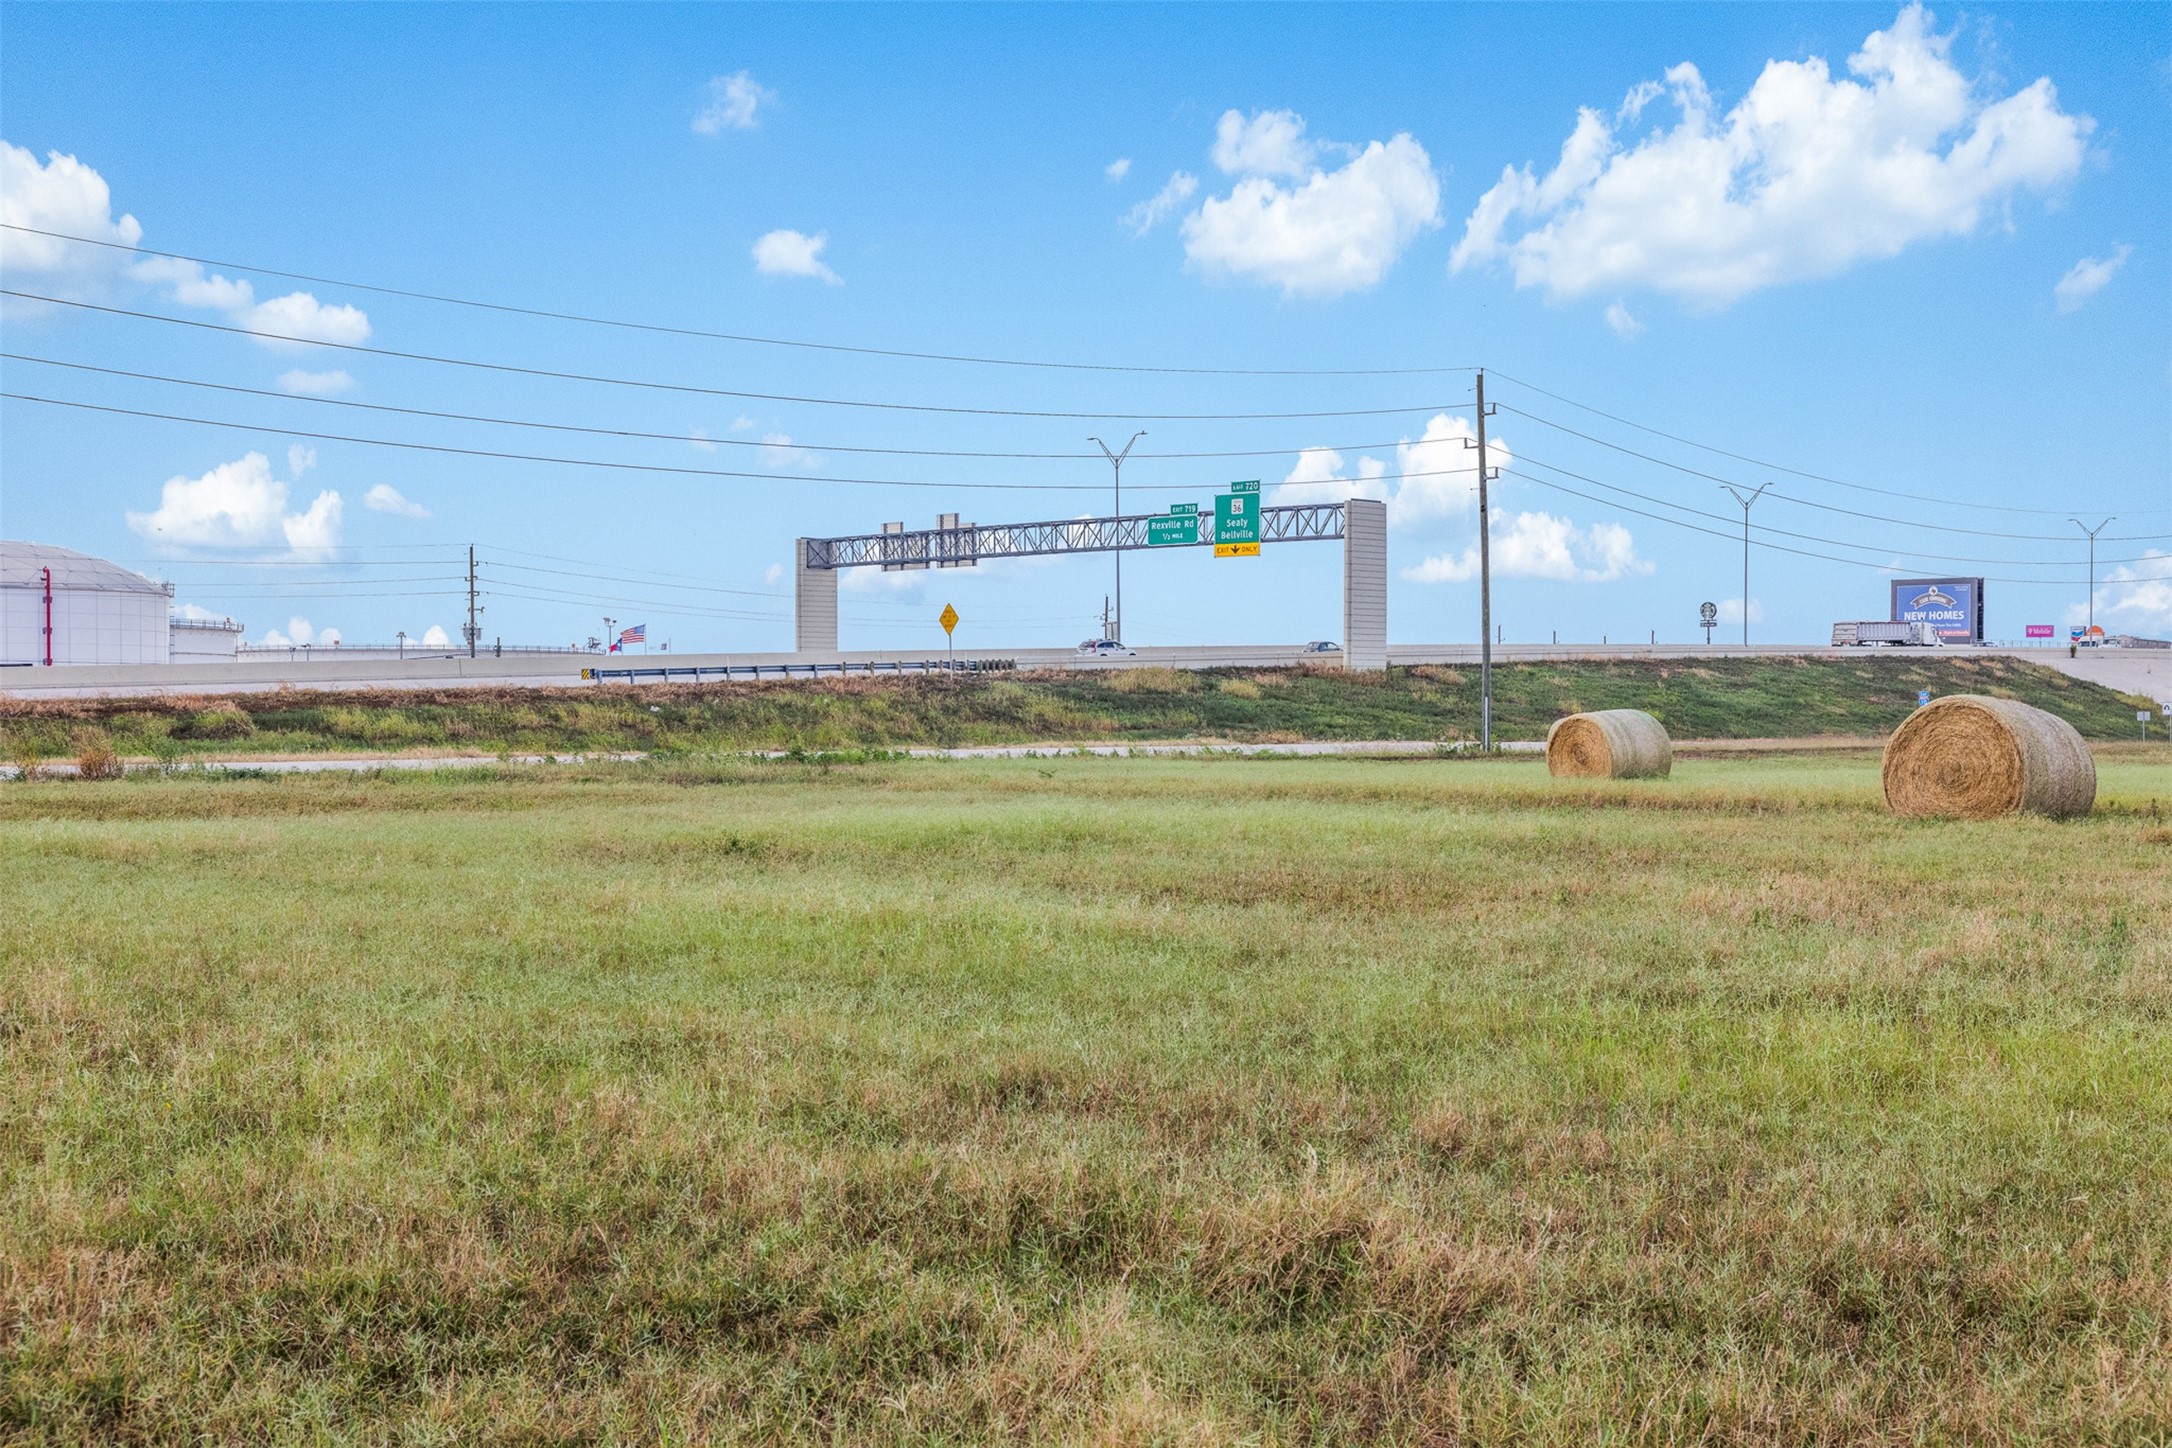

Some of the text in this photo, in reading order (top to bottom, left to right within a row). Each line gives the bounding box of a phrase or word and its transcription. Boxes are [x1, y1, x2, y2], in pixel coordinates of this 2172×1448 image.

[1245, 482, 1258, 490] 720
[1232, 504, 1242, 512] 36
[1151, 520, 1194, 529] Rexville Rd
[1226, 518, 1248, 528] Sealy
[1221, 529, 1253, 539] Bellville
[1904, 610, 1965, 621] NEW HOMES
